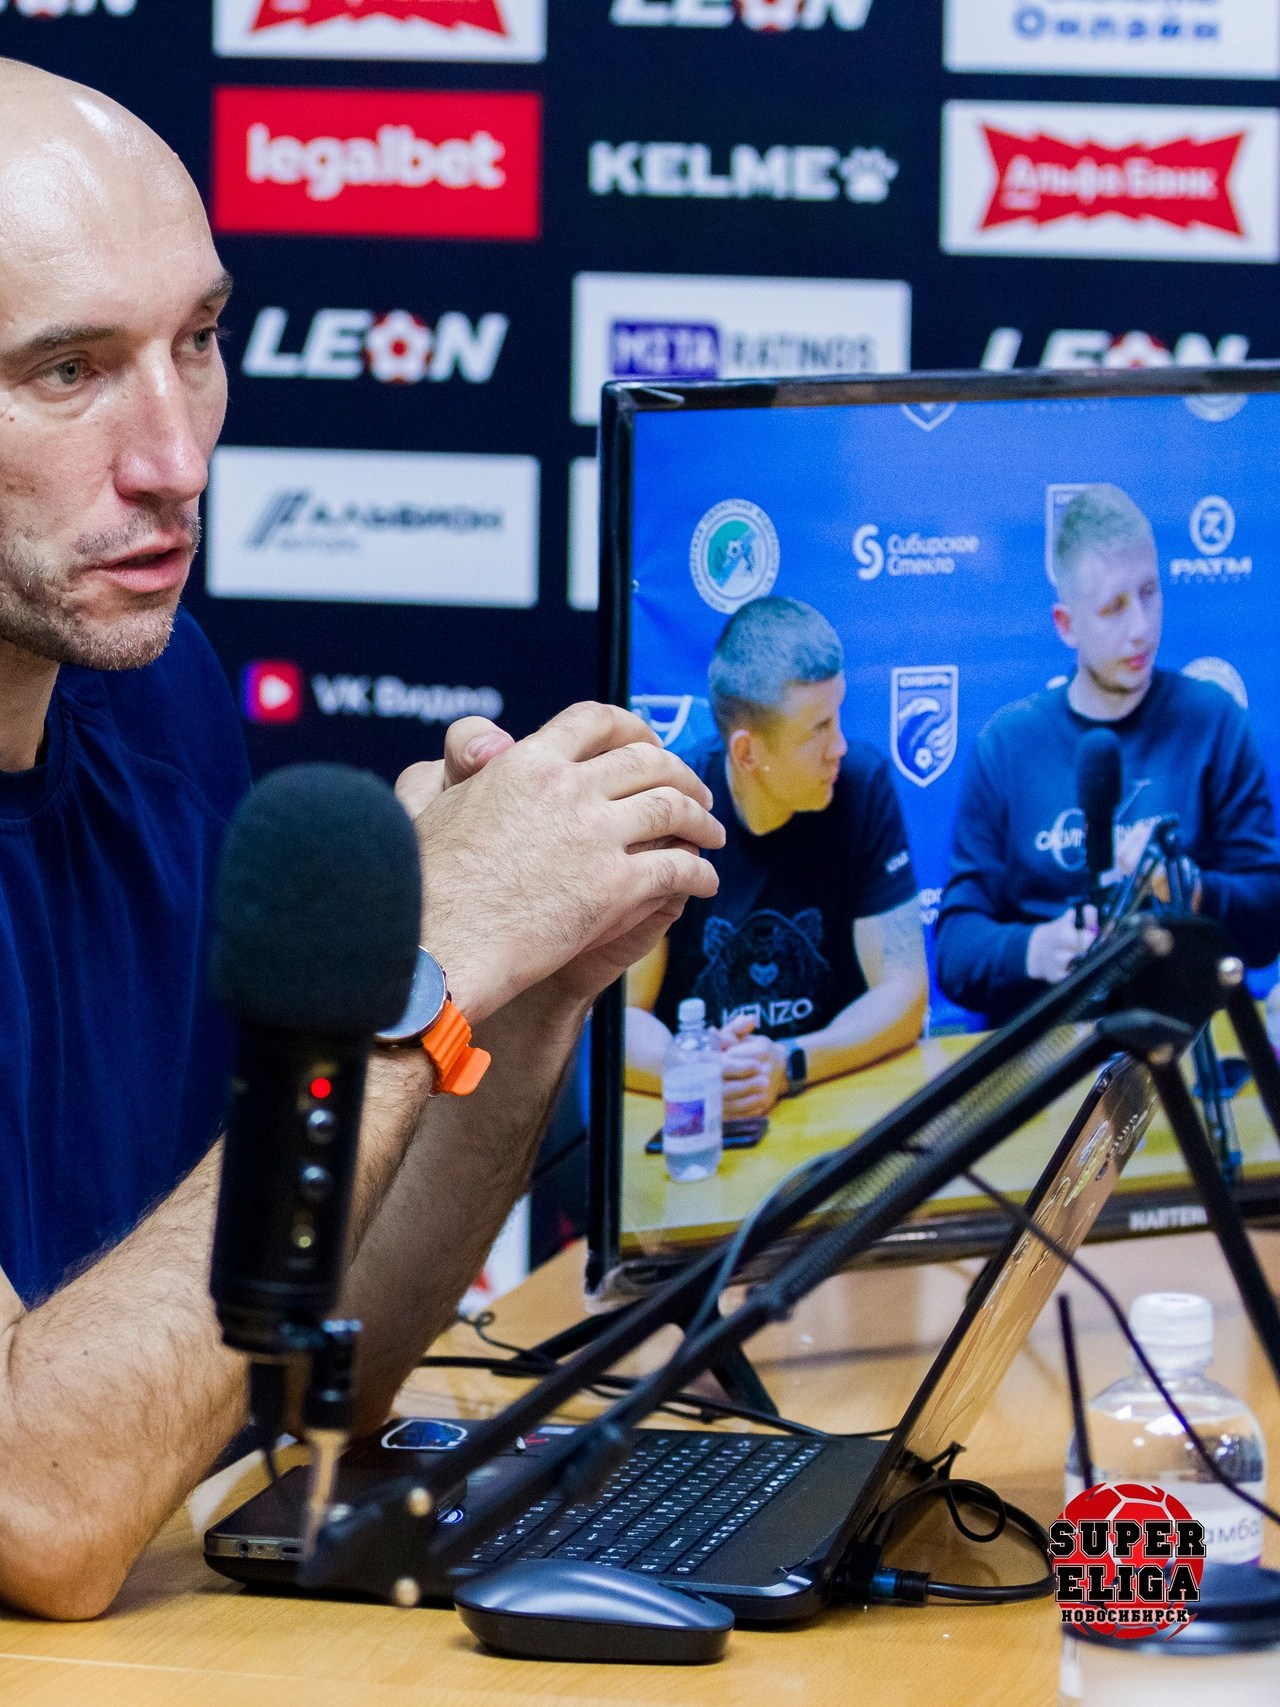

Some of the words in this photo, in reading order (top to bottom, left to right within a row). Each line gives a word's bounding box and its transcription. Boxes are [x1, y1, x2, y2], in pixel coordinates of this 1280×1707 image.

[246, 122, 505, 200] legalbet
[588, 141, 840, 200] KELME
[242, 307, 510, 384] LEON
[311, 674, 371, 716] VK
